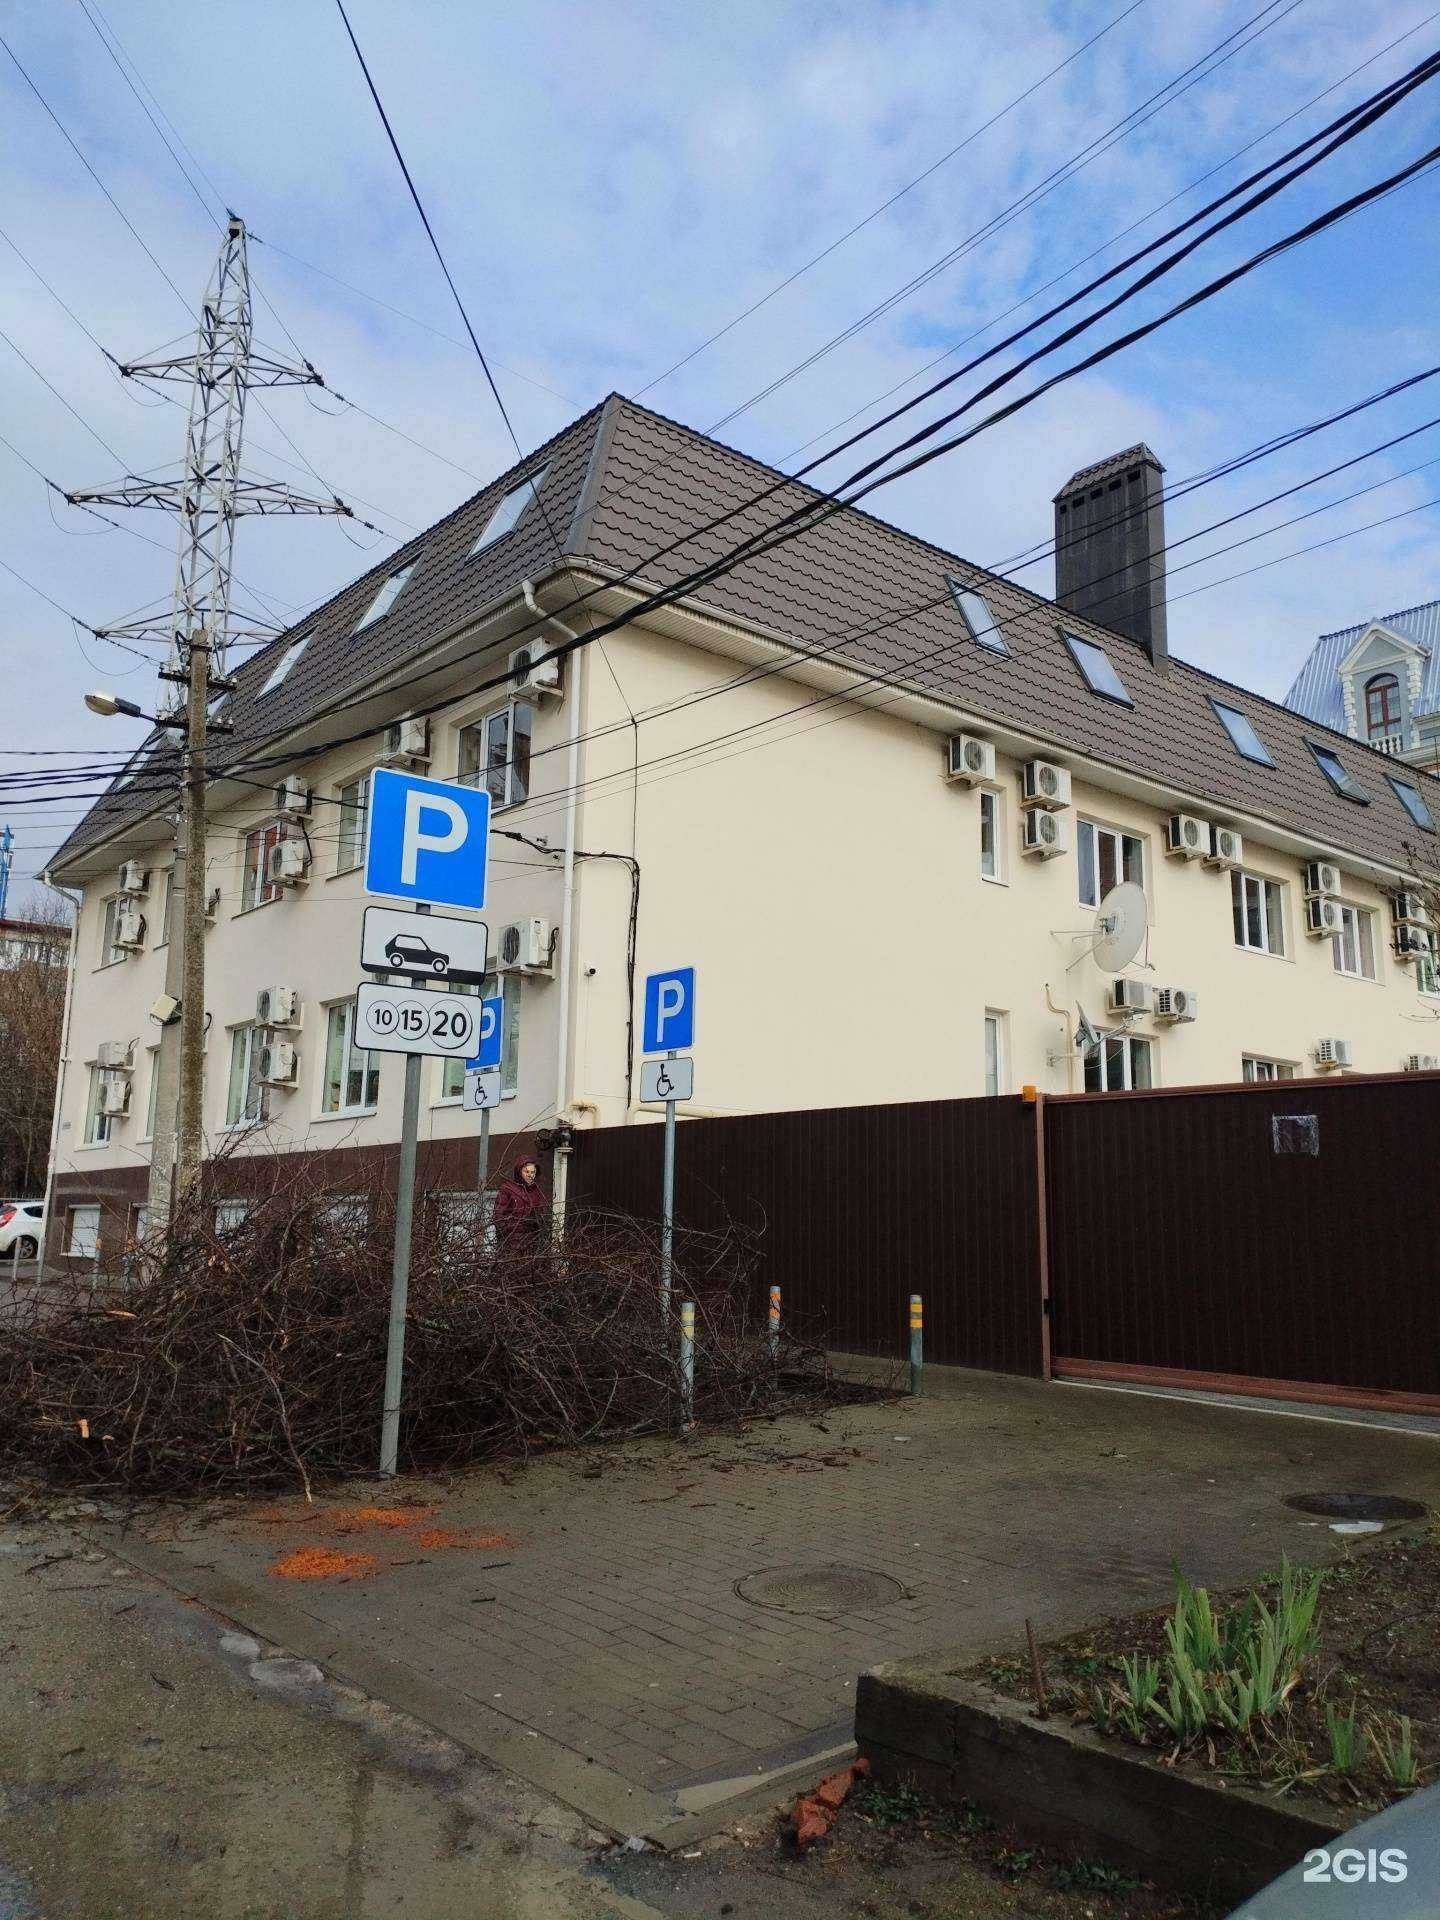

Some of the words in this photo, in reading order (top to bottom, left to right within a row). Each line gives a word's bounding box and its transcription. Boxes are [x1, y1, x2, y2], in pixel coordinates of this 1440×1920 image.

[401, 789, 469, 885] P
[374, 1009, 392, 1025] 10
[401, 1009, 422, 1031] 15
[432, 1010, 467, 1037] 20
[657, 979, 685, 1043] P
